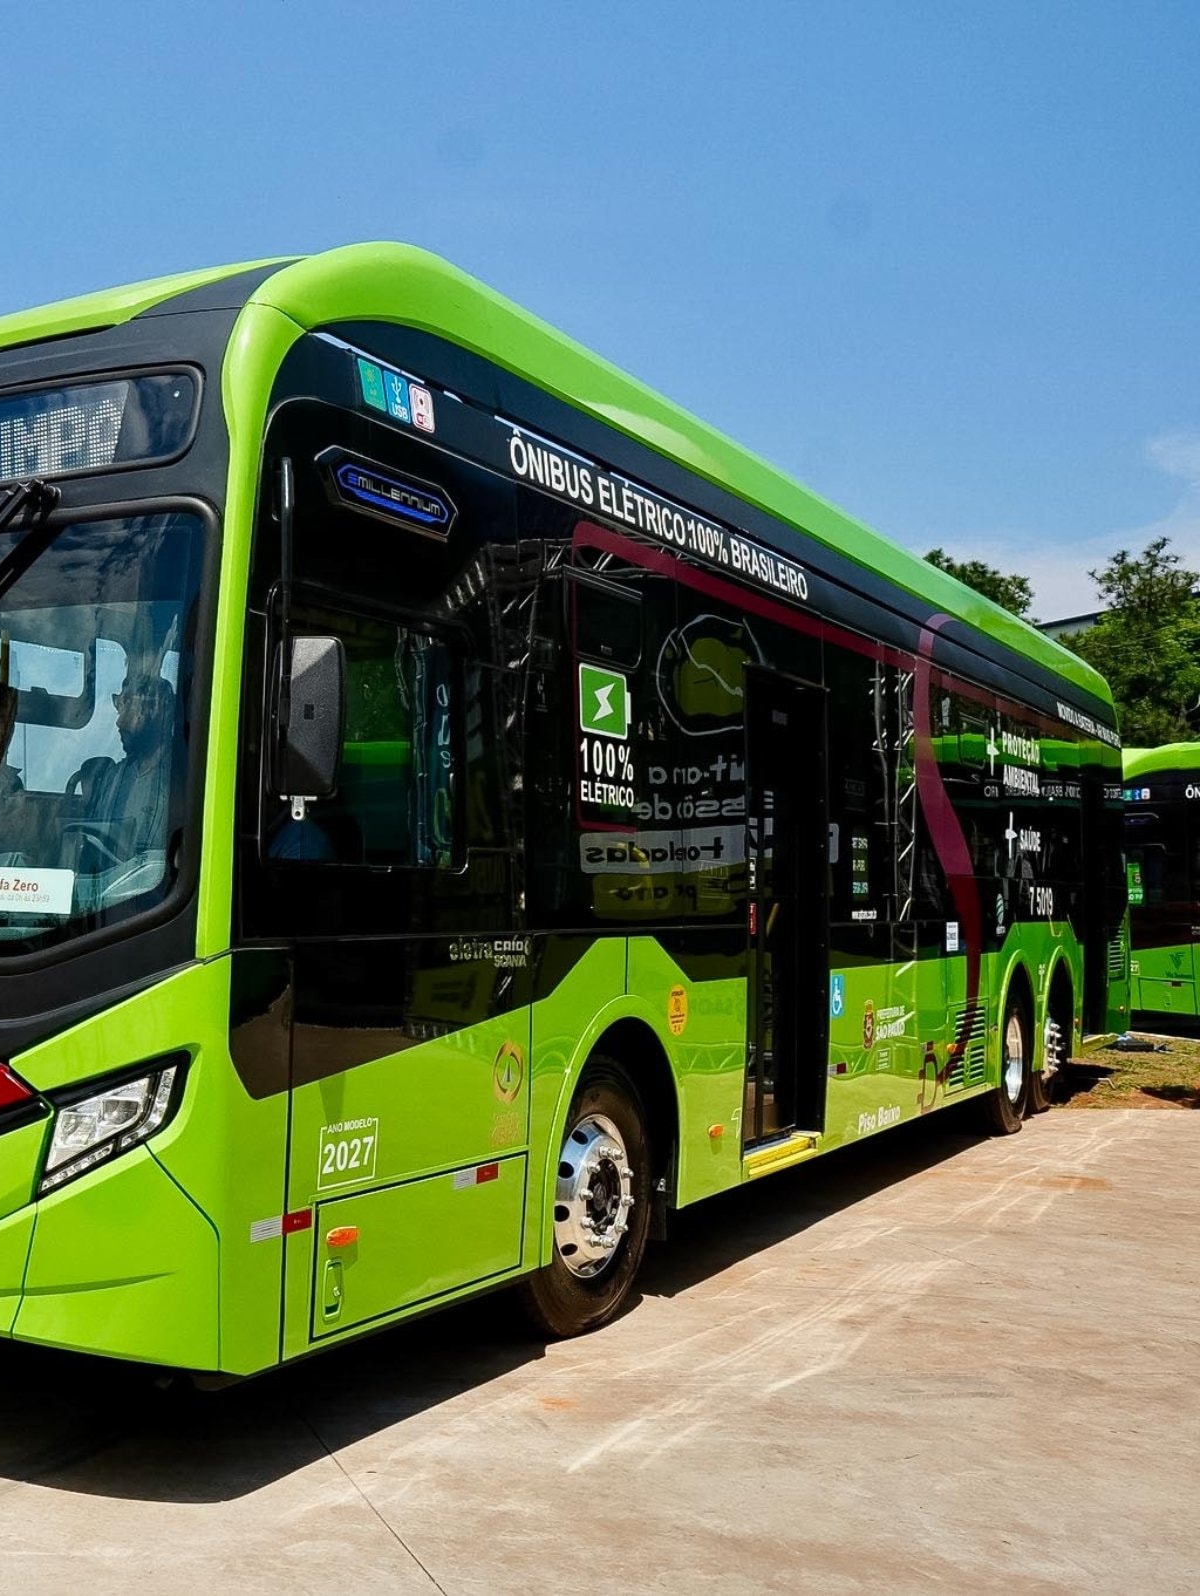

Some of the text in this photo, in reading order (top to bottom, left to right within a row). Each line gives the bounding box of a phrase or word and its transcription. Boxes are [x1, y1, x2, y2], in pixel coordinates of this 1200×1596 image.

[392, 402, 408, 419] USB
[510, 428, 594, 504] ÔNIBUS
[598, 476, 686, 546] ELÉTRICO
[731, 538, 808, 600] BRASILEIRO
[580, 737, 634, 781] 100%
[580, 777, 634, 808] ELÉTRICO
[13, 879, 39, 892] Zero
[494, 940, 523, 951] CAIO
[327, 1117, 372, 1134] ANO MODELO
[322, 1136, 375, 1174] 2027
